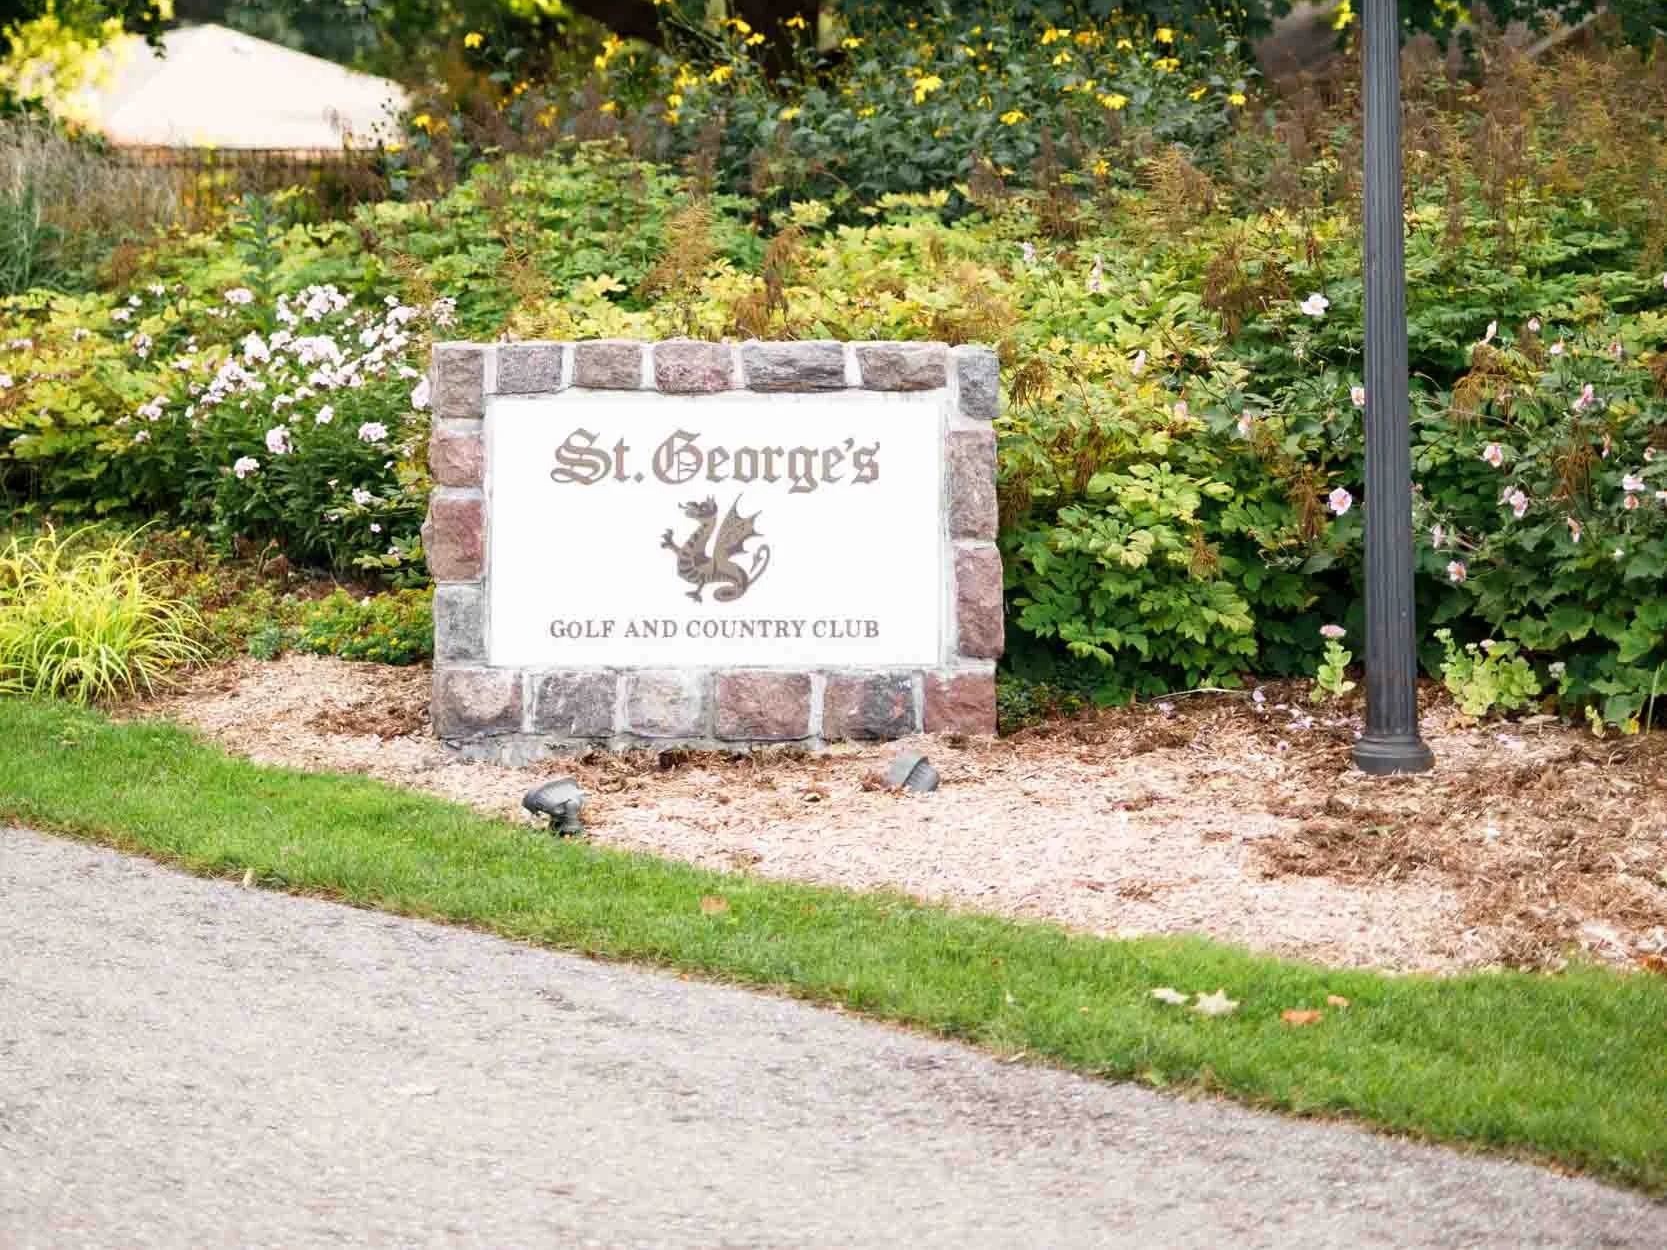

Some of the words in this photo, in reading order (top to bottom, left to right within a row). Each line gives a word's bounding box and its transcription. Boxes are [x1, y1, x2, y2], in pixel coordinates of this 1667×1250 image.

[550, 427, 645, 486] St.
[651, 429, 881, 495] George's
[550, 619, 616, 639] GOLF
[624, 619, 678, 639] AND
[686, 619, 807, 639] COUNTRY
[812, 619, 880, 639] CLUB
